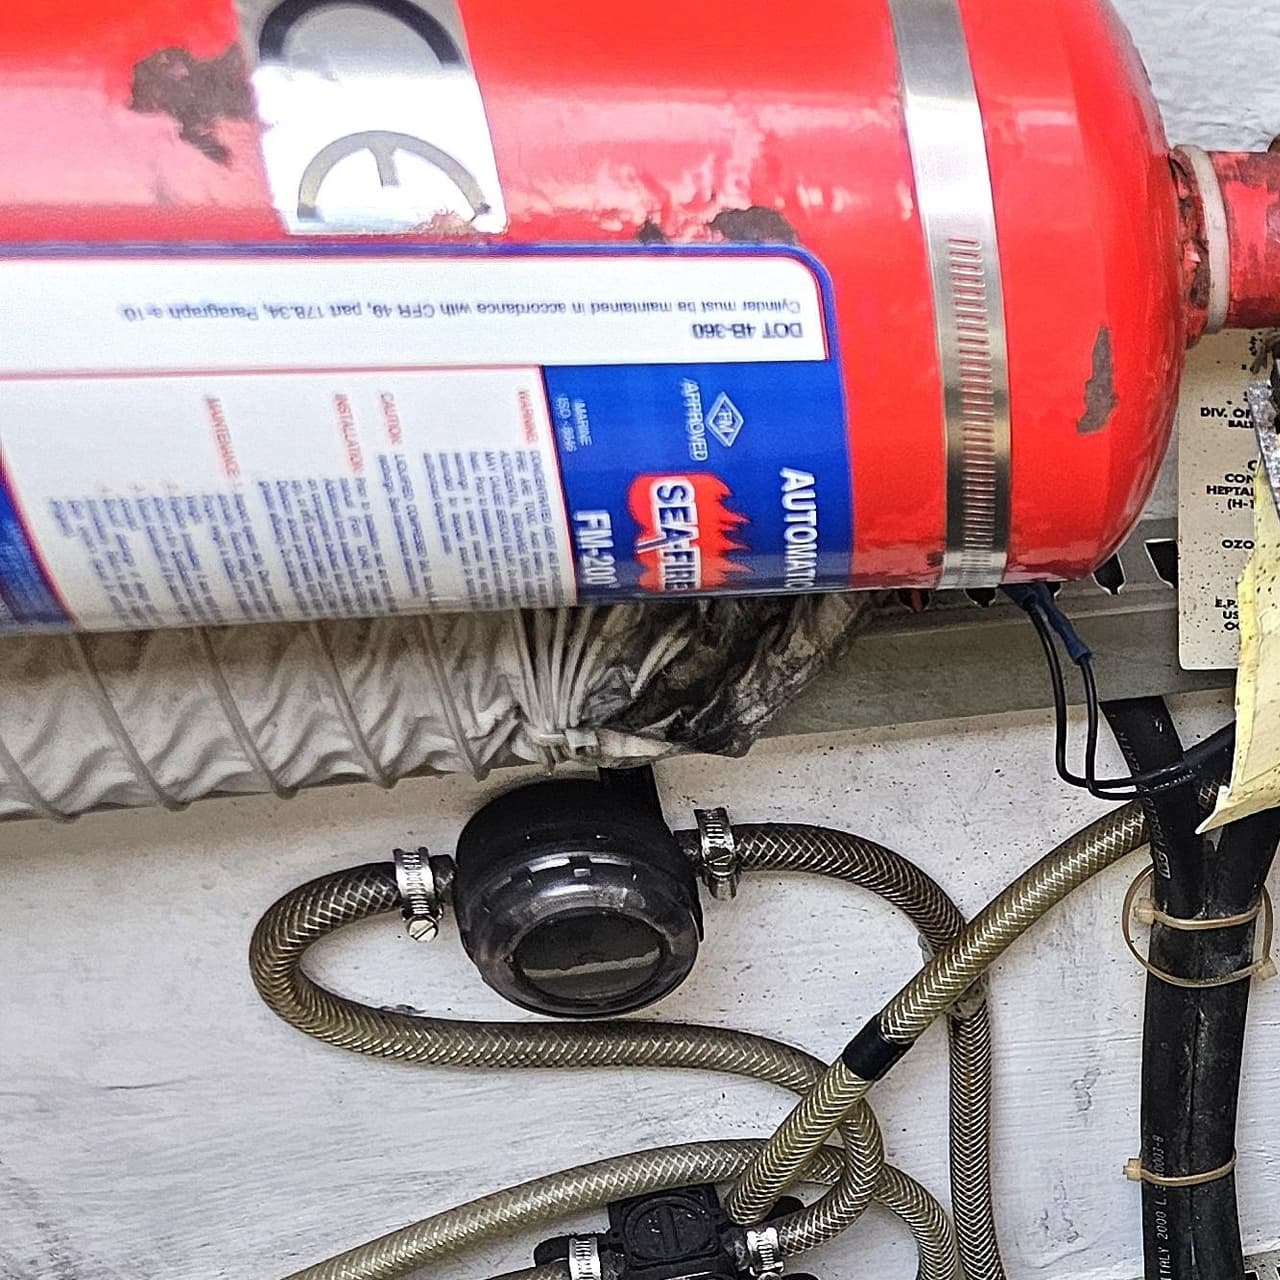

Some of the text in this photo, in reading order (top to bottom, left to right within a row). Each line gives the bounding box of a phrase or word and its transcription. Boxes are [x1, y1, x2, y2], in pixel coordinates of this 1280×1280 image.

[168, 301, 257, 321] Paragraph
[397, 302, 434, 318] CFR
[439, 302, 470, 317] with
[476, 301, 566, 315] accordance
[571, 301, 583, 315] in
[590, 300, 671, 315] maintained
[700, 300, 736, 313] must
[763, 321, 802, 338] DOT
[680, 379, 708, 461] APPROVED
[1200, 407, 1227, 418] DIV.
[573, 400, 592, 446] MARINE
[718, 410, 734, 433] FM
[1156, 1211, 1167, 1238] 2000
[1159, 1246, 1171, 1280] ITALY
